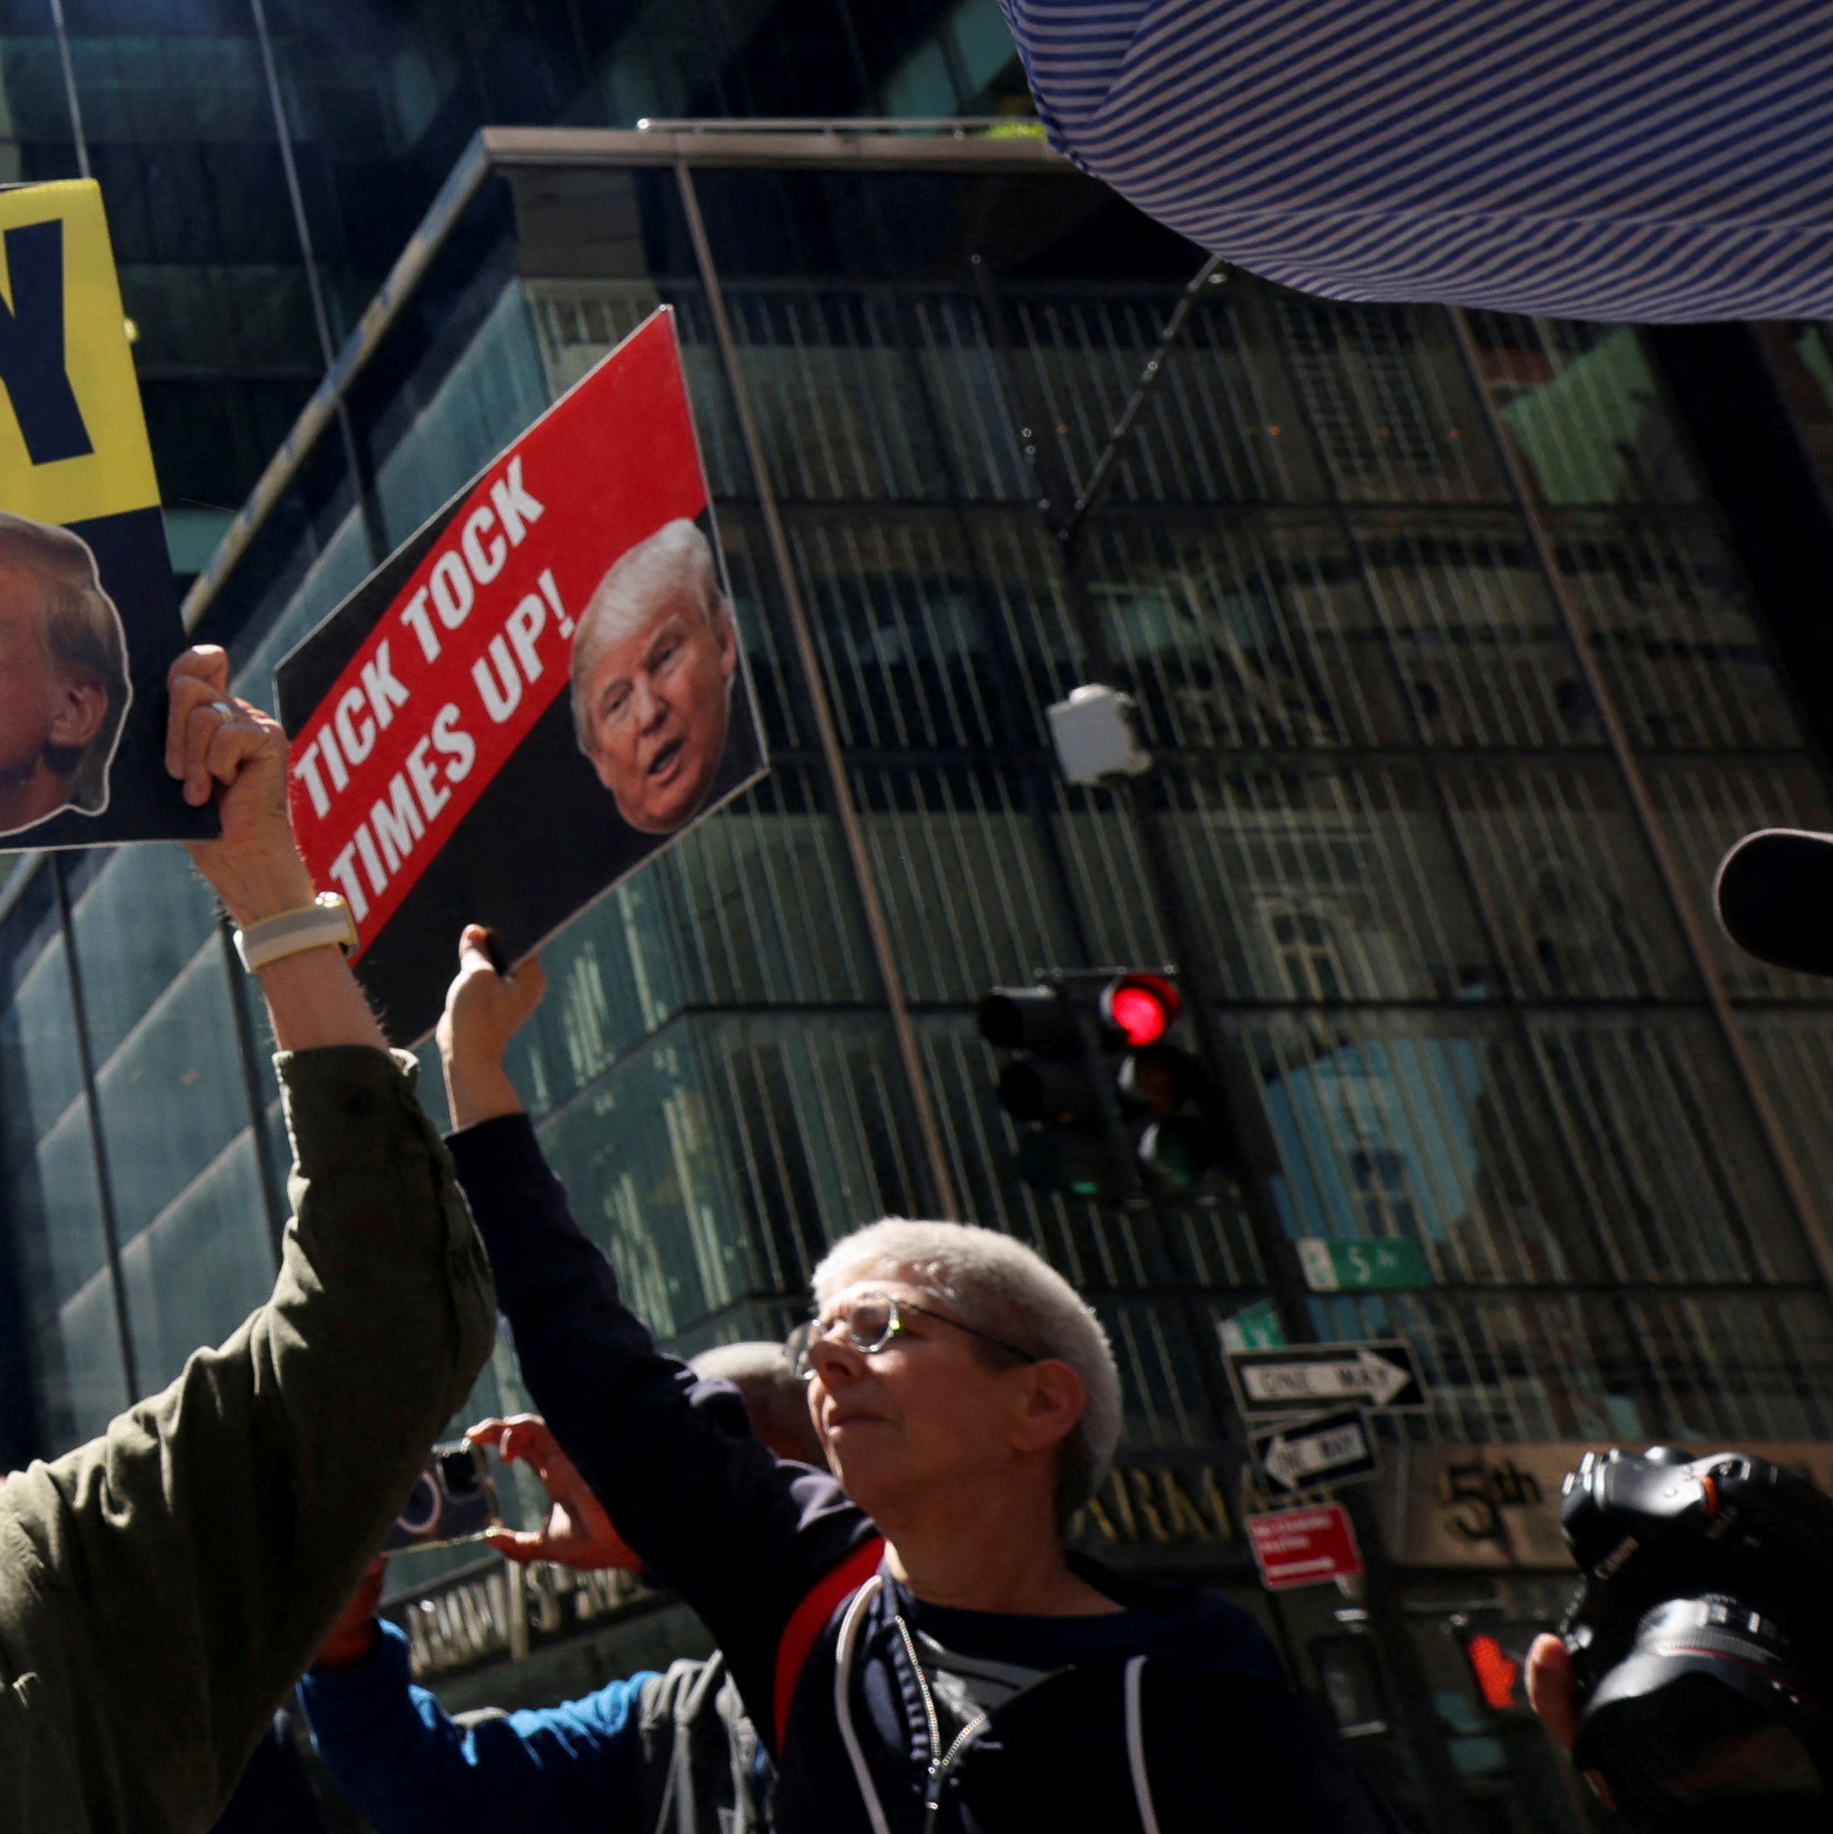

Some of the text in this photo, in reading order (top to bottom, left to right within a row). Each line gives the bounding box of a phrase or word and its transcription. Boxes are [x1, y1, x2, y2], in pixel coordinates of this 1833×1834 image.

[293, 453, 546, 821] TICK TOCK
[328, 568, 576, 924] TIMES UP!
[1442, 1463, 1542, 1538] 5th
